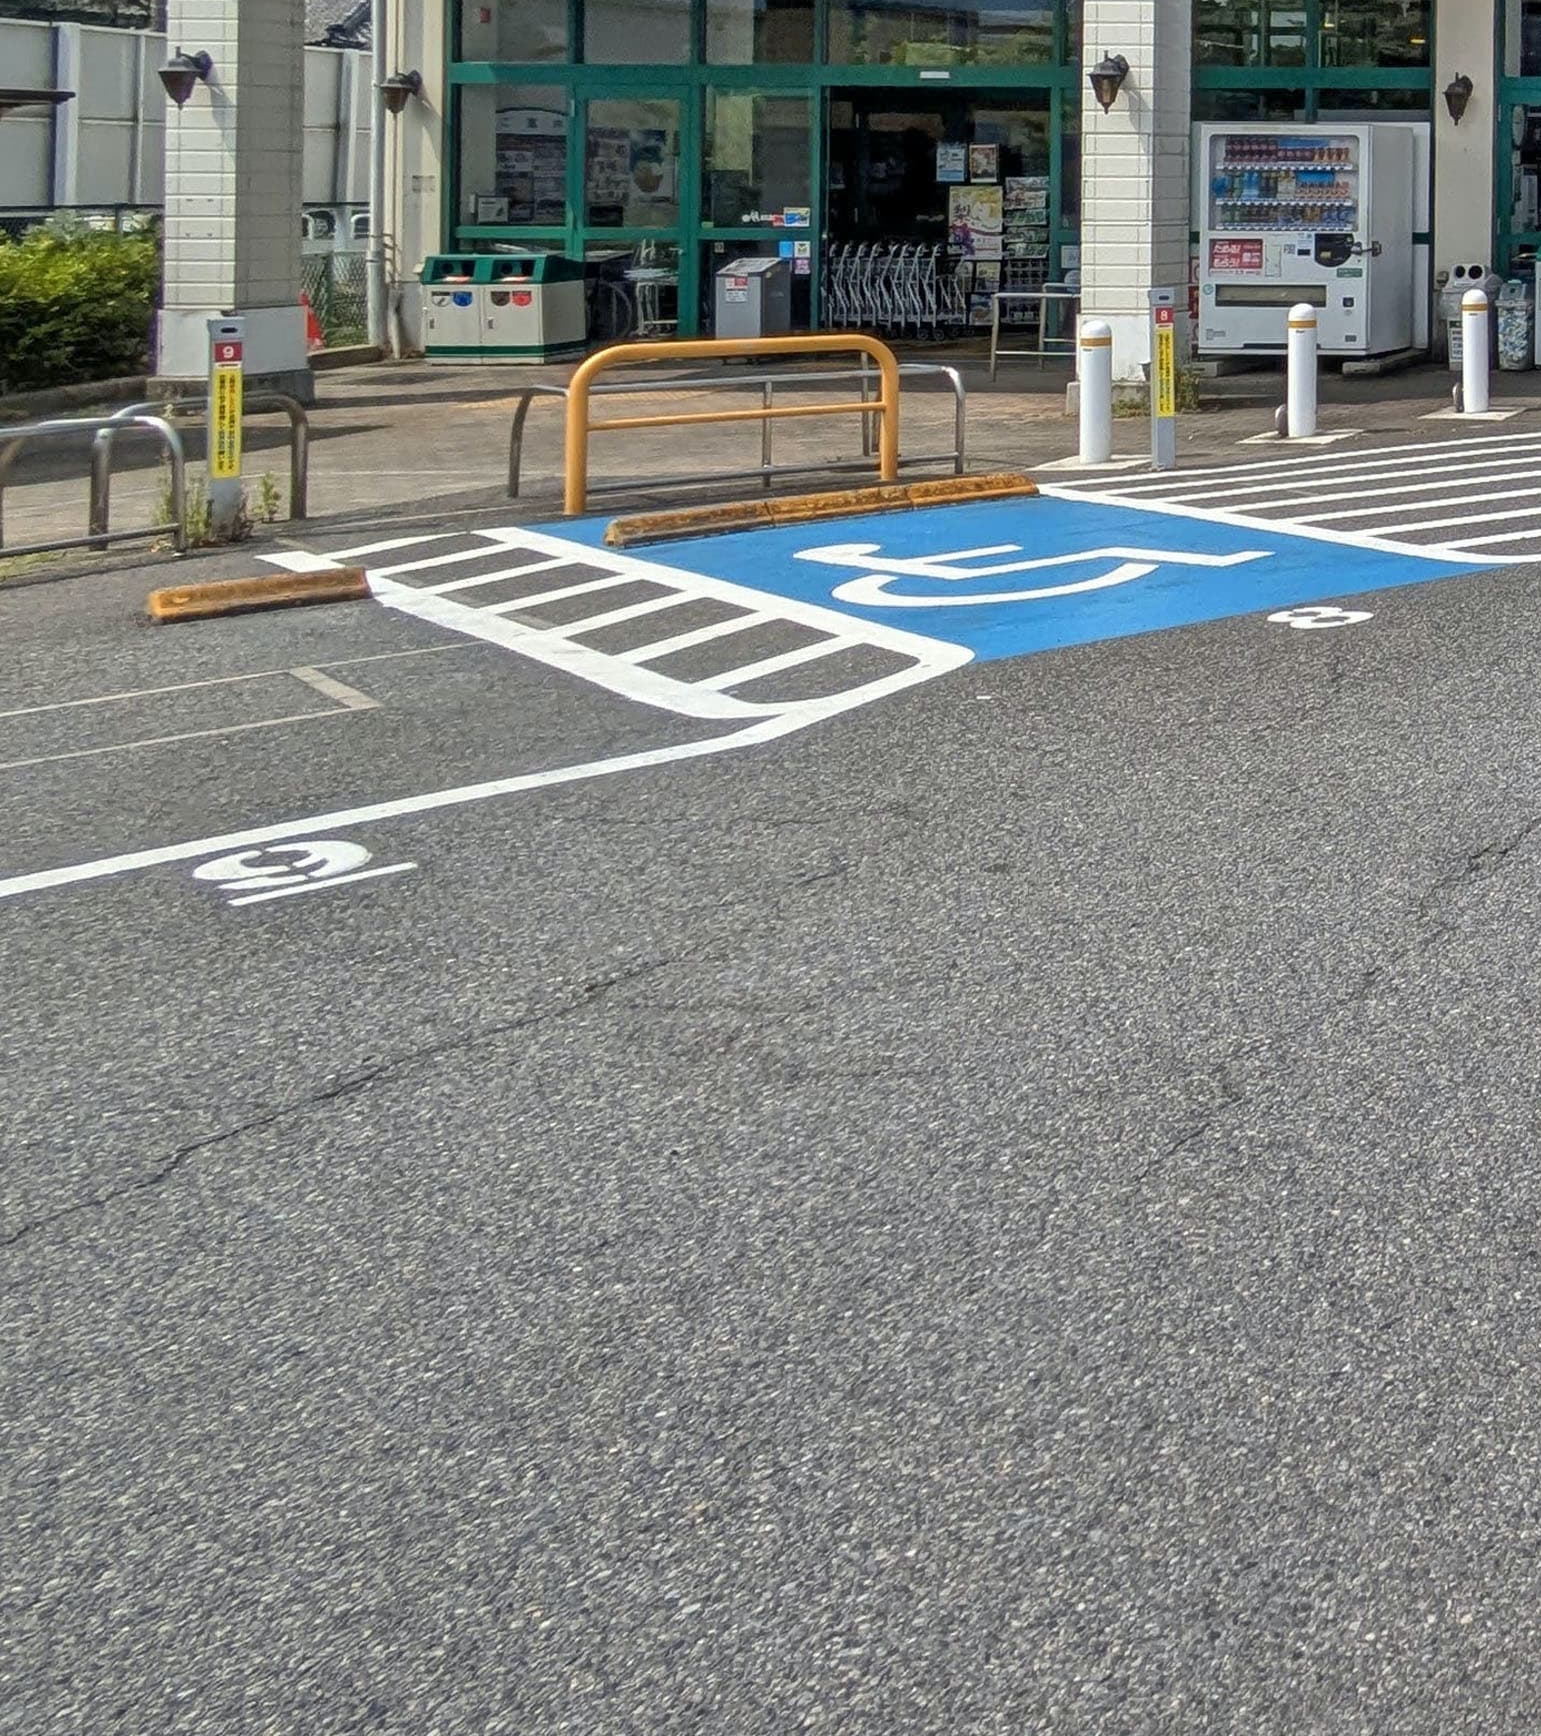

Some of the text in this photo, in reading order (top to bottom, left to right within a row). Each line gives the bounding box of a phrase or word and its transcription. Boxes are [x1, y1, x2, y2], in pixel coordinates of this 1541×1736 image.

[1160, 310, 1168, 321] 8
[222, 345, 235, 359] 9
[1266, 606, 1375, 630] 8
